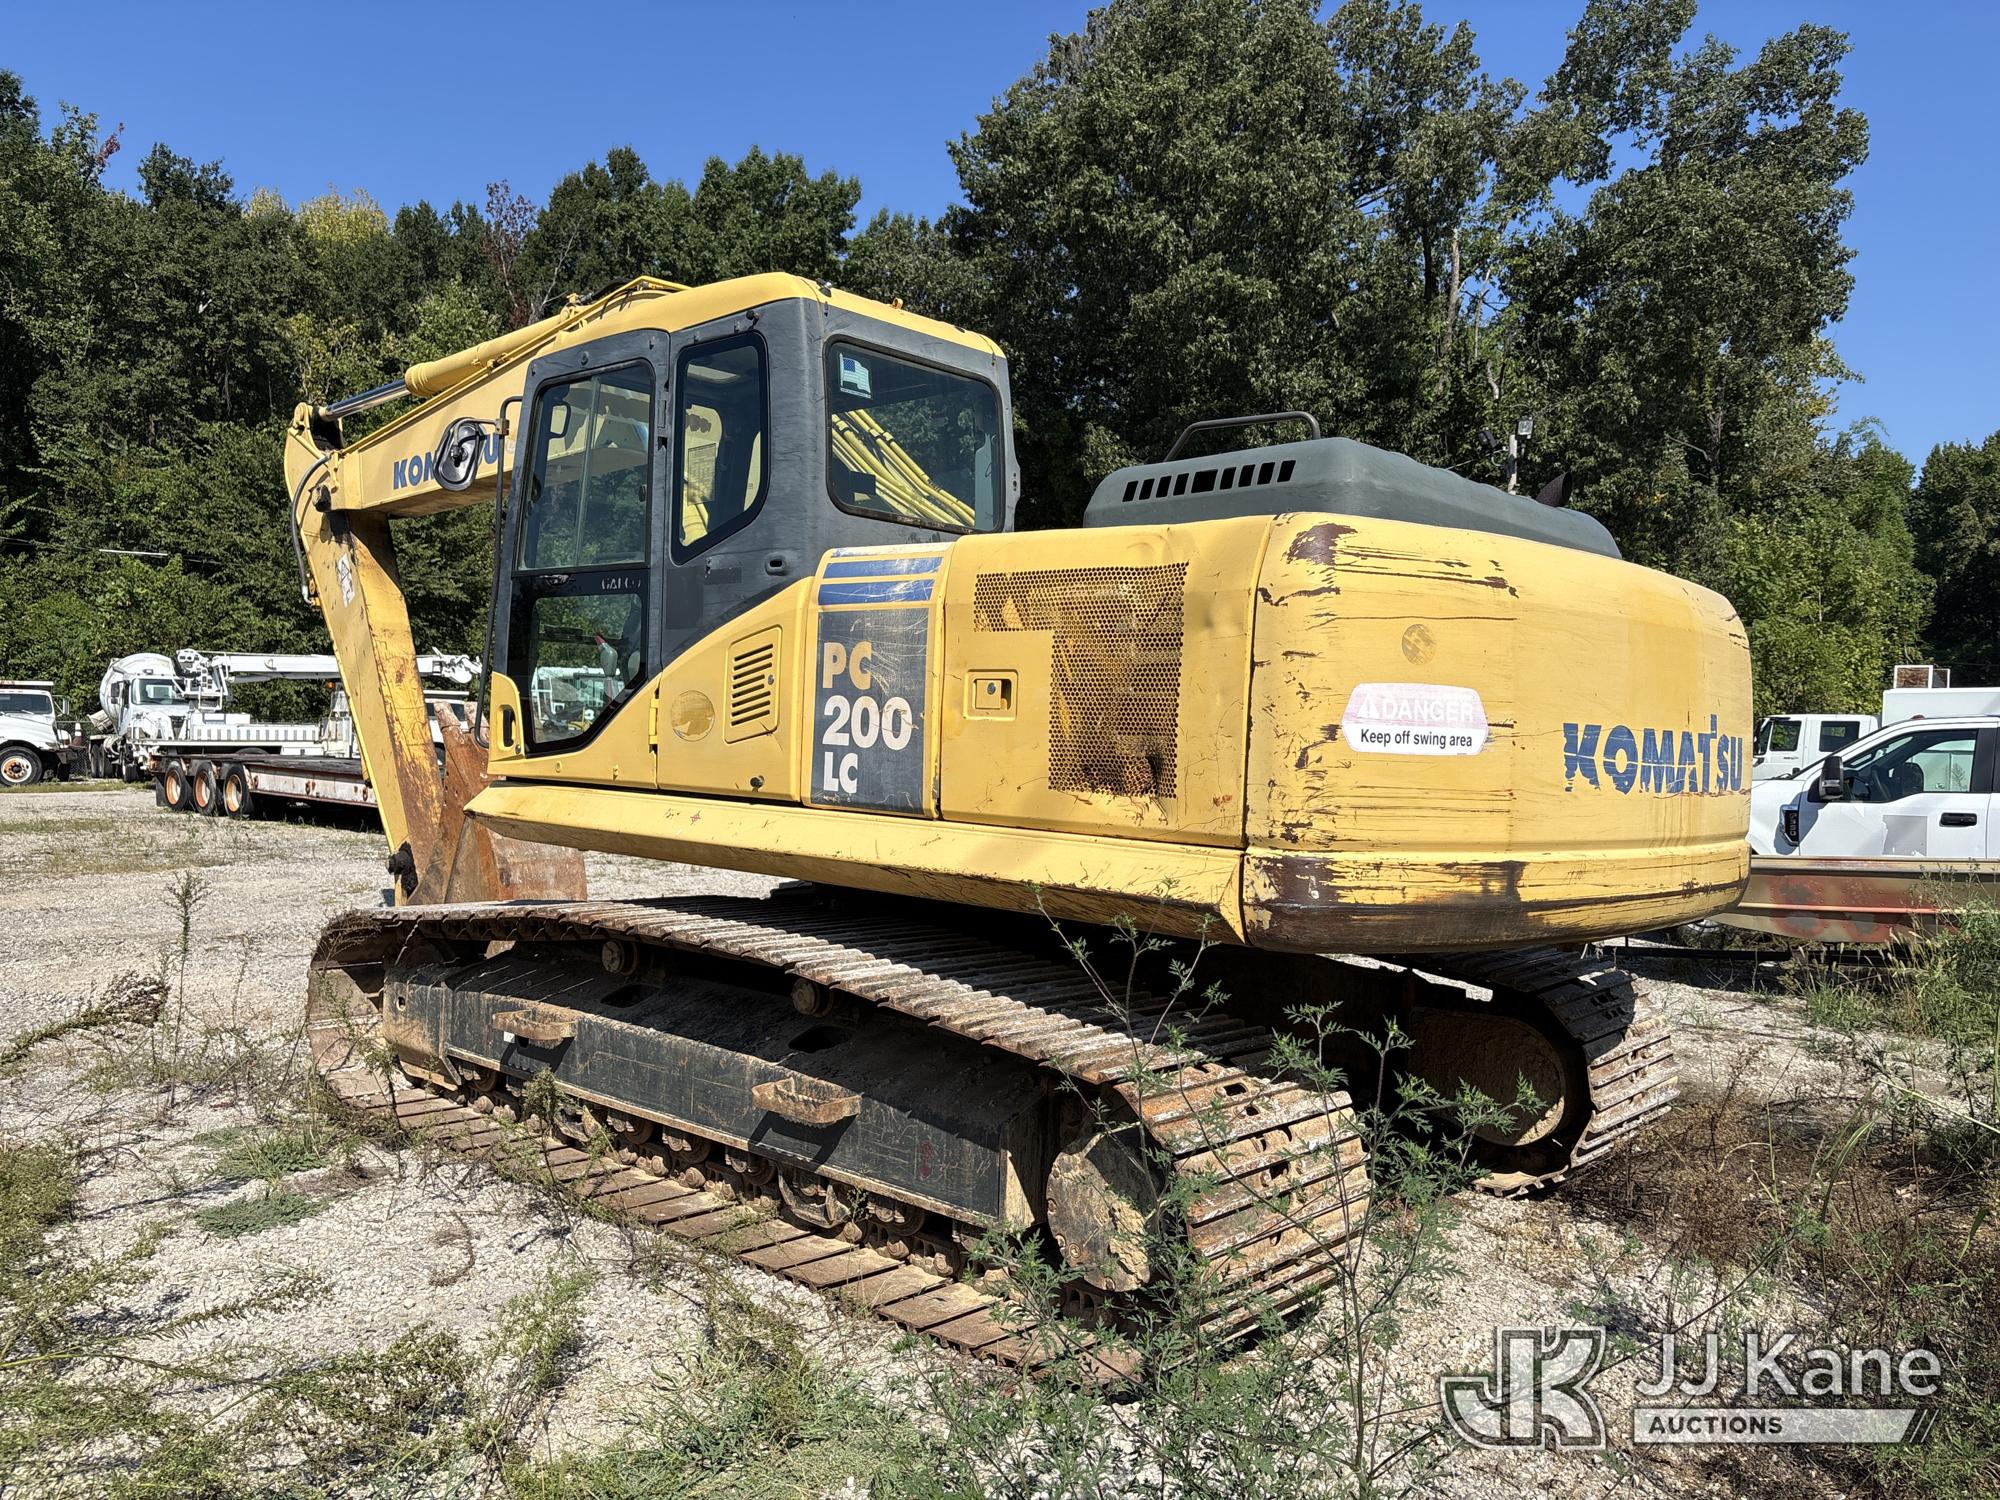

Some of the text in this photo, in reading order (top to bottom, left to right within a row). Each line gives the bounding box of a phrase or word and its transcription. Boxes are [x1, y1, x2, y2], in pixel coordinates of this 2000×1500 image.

[822, 641, 872, 690] PC
[822, 695, 913, 750] 200
[1382, 698, 1474, 723] DANGER
[1360, 728, 1473, 749] Keep off swing area
[1563, 713, 1743, 795] KOMATSU
[823, 751, 859, 794] LC
